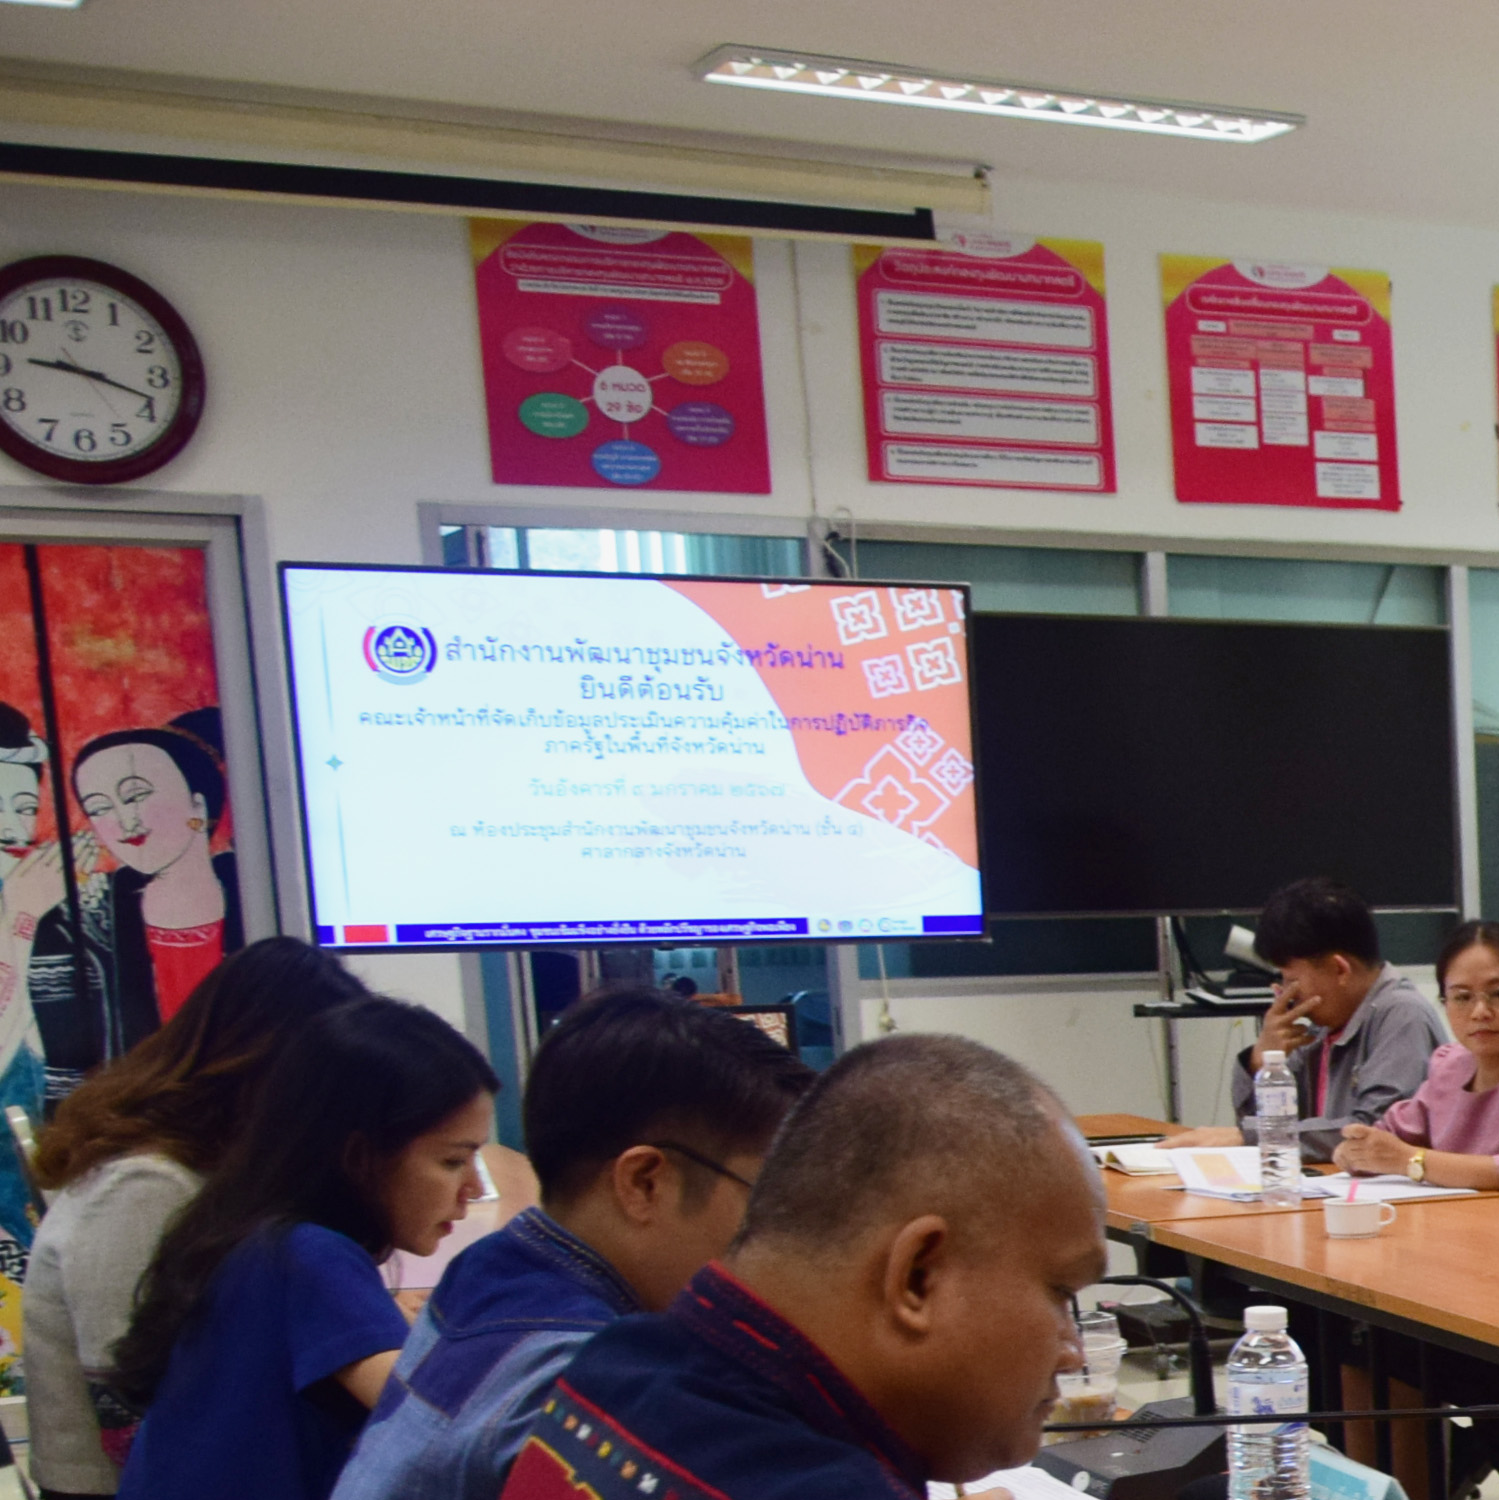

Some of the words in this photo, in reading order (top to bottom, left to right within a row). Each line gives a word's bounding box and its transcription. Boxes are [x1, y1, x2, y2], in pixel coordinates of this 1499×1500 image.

[27, 296, 53, 322] 11
[58, 288, 91, 313] 12
[107, 302, 119, 326] 1
[0, 319, 29, 344] 10
[135, 330, 155, 354] 2
[147, 365, 170, 389] 3
[3, 387, 27, 412] 8
[135, 396, 156, 423] 4
[38, 418, 60, 442] 7
[74, 428, 97, 452] 6
[109, 423, 132, 446] 5
[444, 634, 845, 673] สำนักงานพัฒนาชุมชนจังหวัดน่าน
[580, 674, 724, 702] ยินดีต้อนรับ
[544, 730, 766, 760] ภาครัฐในพื้นที่จังหวัดน่าน
